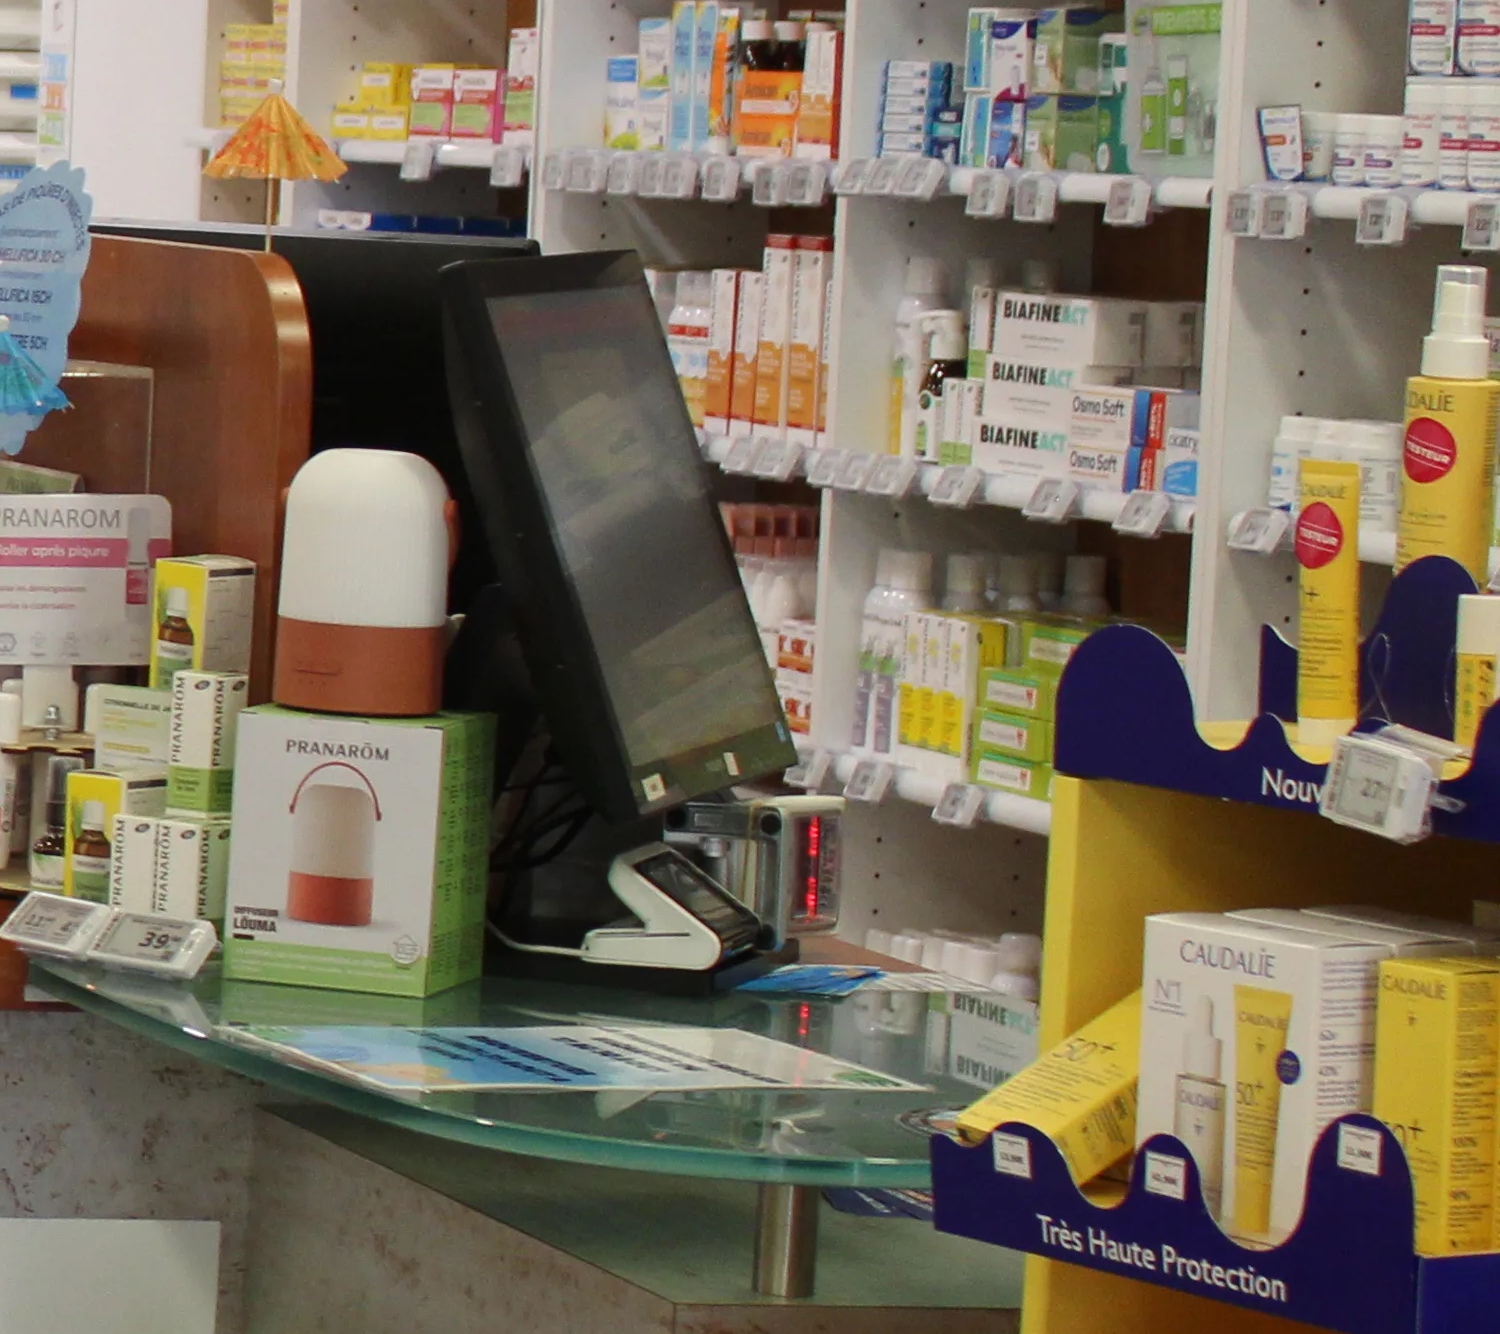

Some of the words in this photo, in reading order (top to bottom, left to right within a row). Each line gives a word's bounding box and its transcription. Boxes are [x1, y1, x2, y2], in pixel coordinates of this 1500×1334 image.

[32, 544, 65, 559] après
[1036, 1213, 1082, 1253] Très
[1089, 1227, 1156, 1271] Haute
[1161, 1244, 1287, 1303] Protection
